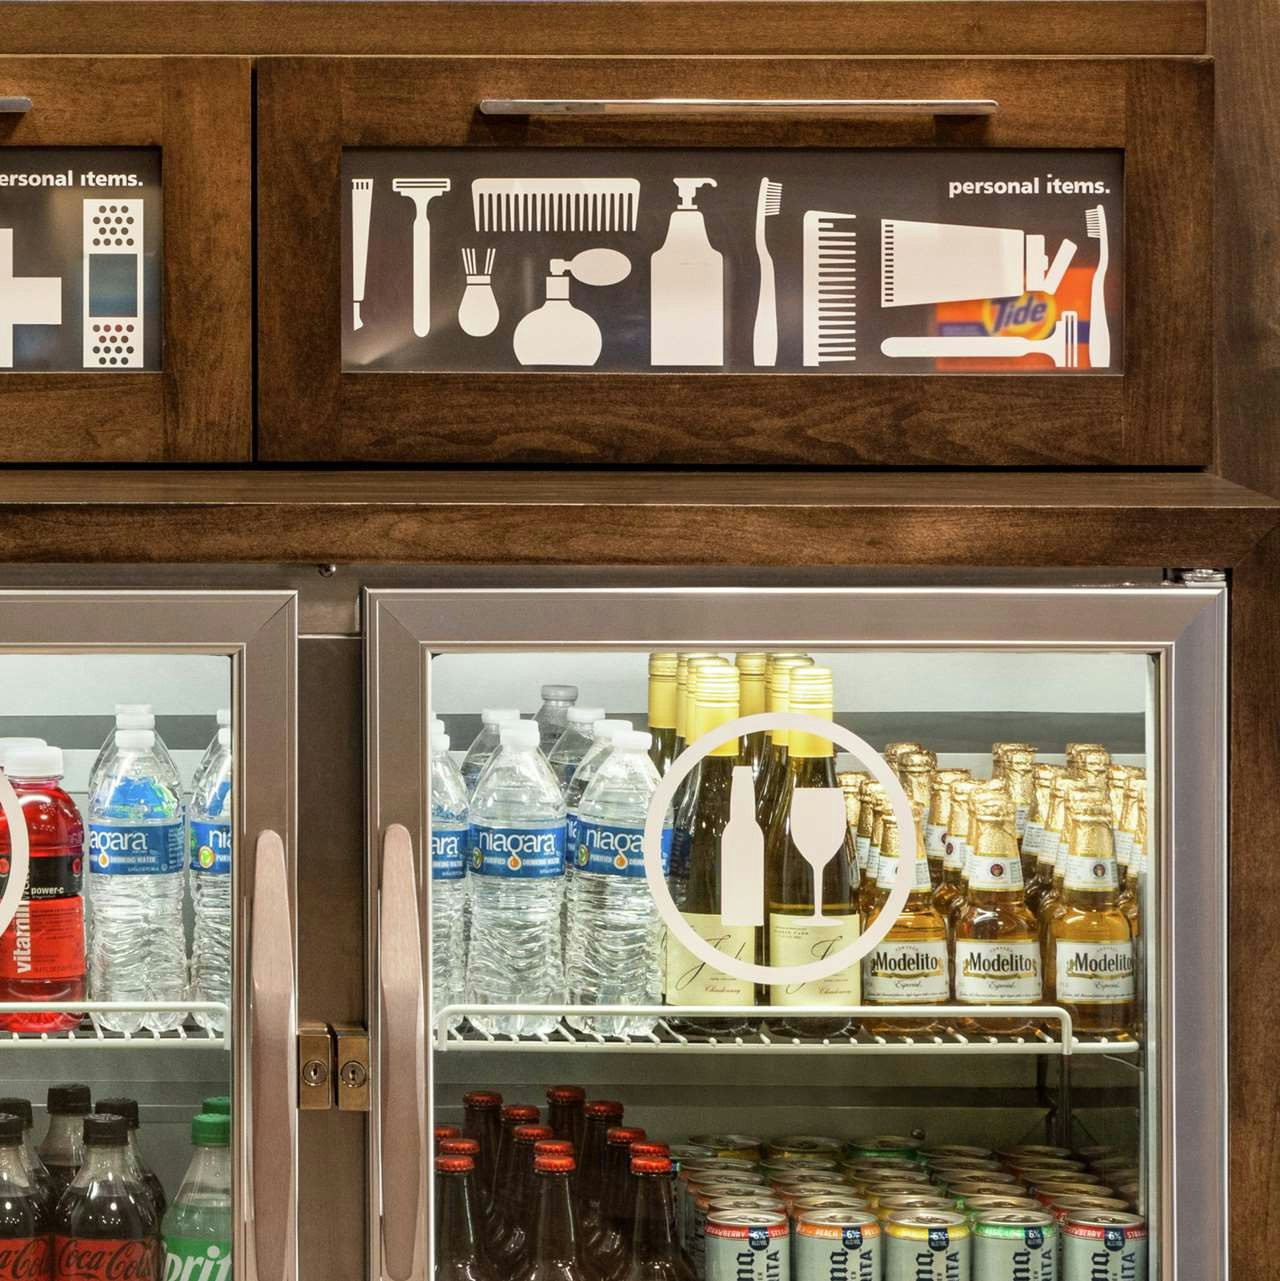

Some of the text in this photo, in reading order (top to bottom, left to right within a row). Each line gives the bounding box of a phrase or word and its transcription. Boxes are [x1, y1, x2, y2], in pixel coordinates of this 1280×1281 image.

[81, 171, 143, 187] items.
[949, 174, 1111, 197] personal items.
[992, 297, 1047, 334] Tide
[480, 831, 555, 853] niagara
[31, 886, 64, 894] power-c
[875, 952, 937, 970] Modelito
[970, 952, 1031, 971] Modelito
[1075, 953, 1133, 971] Modelito
